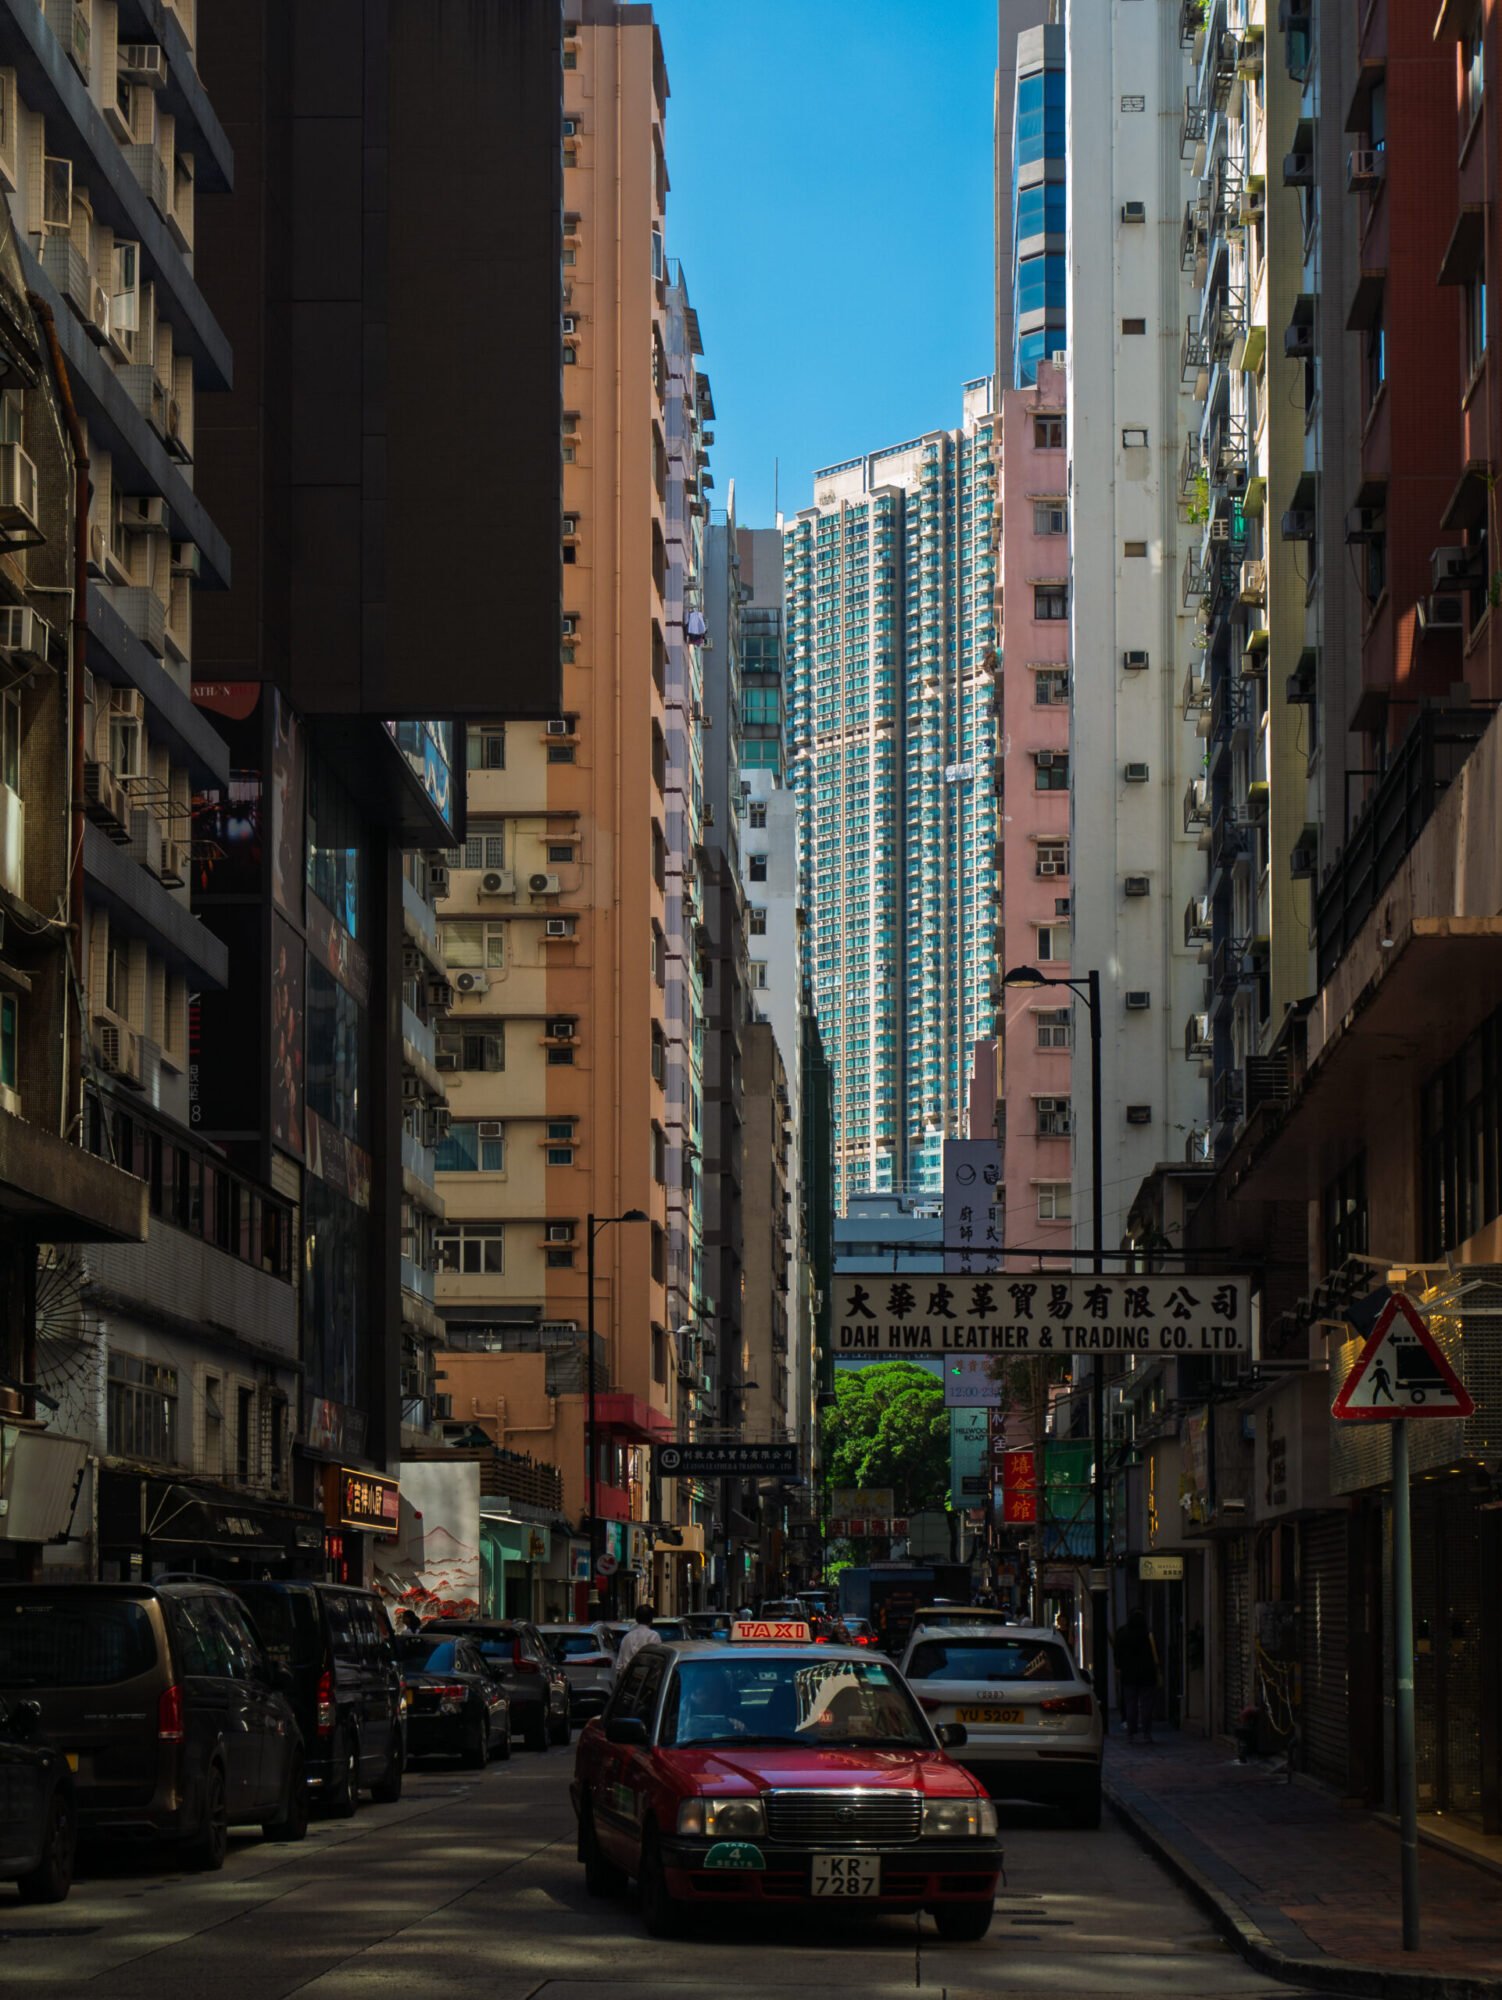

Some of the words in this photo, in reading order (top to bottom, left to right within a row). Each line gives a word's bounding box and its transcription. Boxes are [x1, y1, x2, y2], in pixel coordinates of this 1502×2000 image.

[846, 1283, 1237, 1320] 大華皮革貿易有限公司
[841, 1326, 879, 1347] DAH
[889, 1326, 932, 1347] HWA
[943, 1326, 1029, 1347] LEATHER
[1039, 1326, 1052, 1348] &
[1062, 1326, 1149, 1348] TRADING
[1160, 1326, 1192, 1348] CO.
[1201, 1326, 1243, 1348] LTD.
[970, 1416, 977, 1426] 7
[738, 1623, 804, 1638] TAXI
[960, 1709, 978, 1721] YU
[984, 1710, 1020, 1721] 5207
[729, 1848, 741, 1860] 4
[831, 1859, 860, 1876] KR
[816, 1877, 875, 1895] 7287
